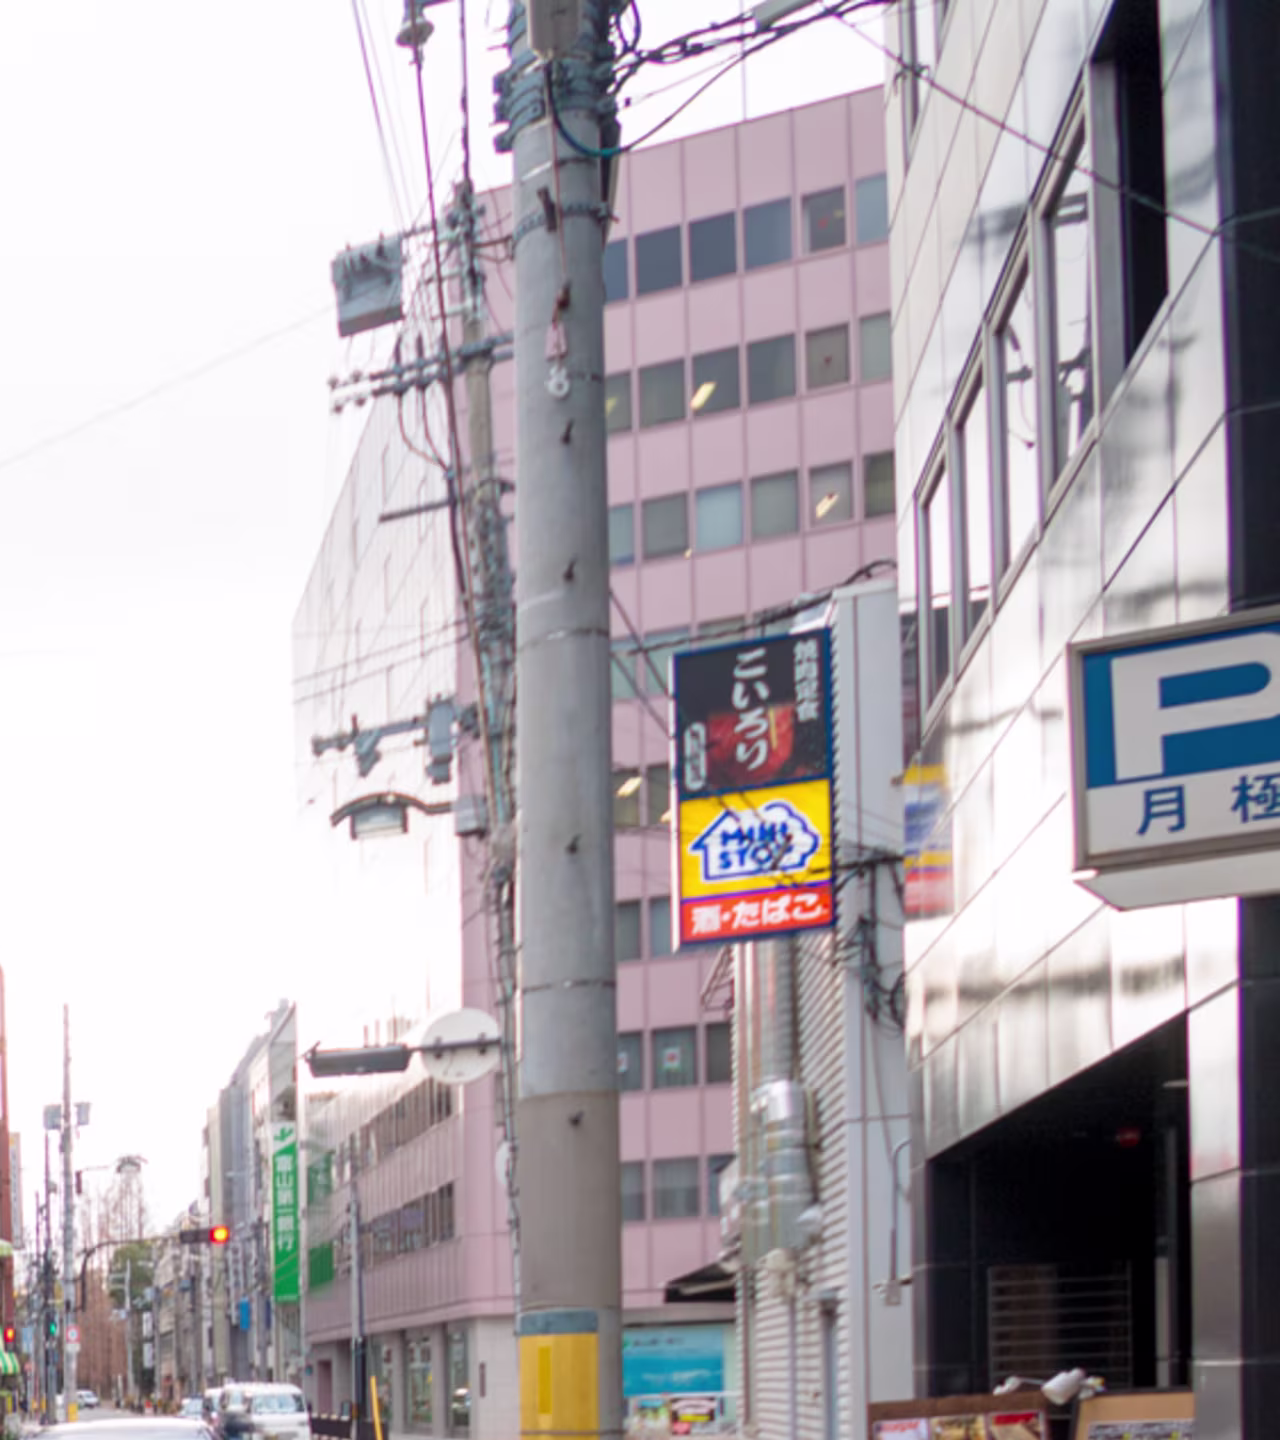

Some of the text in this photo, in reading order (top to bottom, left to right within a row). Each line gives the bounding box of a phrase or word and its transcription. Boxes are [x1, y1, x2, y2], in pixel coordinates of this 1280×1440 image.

[732, 647, 770, 772] こいろり
[1111, 632, 1280, 781] P
[1137, 774, 1280, 836] 月極
